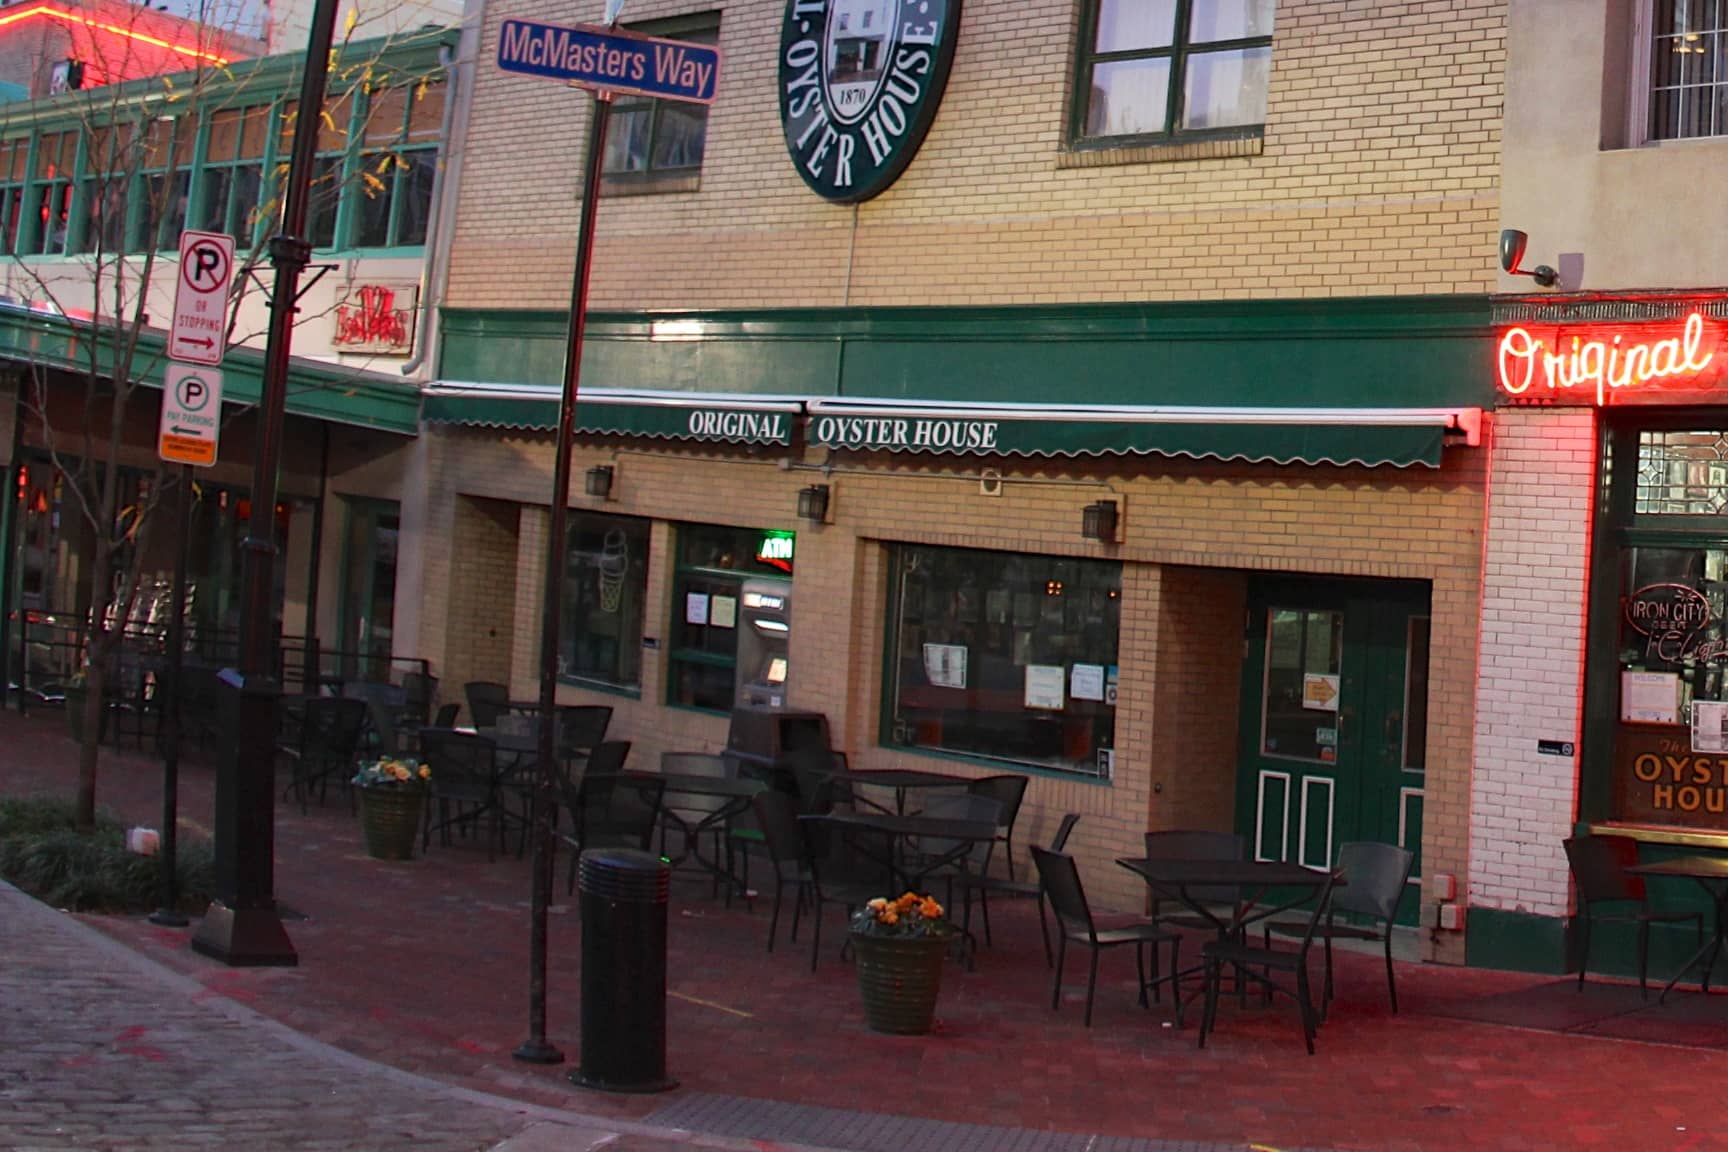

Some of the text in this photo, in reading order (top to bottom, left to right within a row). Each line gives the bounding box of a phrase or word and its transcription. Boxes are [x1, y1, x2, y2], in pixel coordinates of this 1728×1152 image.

[502, 23, 712, 97] McMasters Way
[786, 21, 938, 187] OYSTER HOUSE
[839, 88, 867, 105] 1870
[194, 247, 220, 282] P
[178, 314, 221, 332] STOPPING
[1497, 311, 1713, 406] Original
[185, 382, 203, 404] P
[688, 410, 998, 449] ORIGINAL OYSTER HOUSE
[1633, 601, 1704, 621] IRON CITY
[1659, 738, 1689, 753] The
